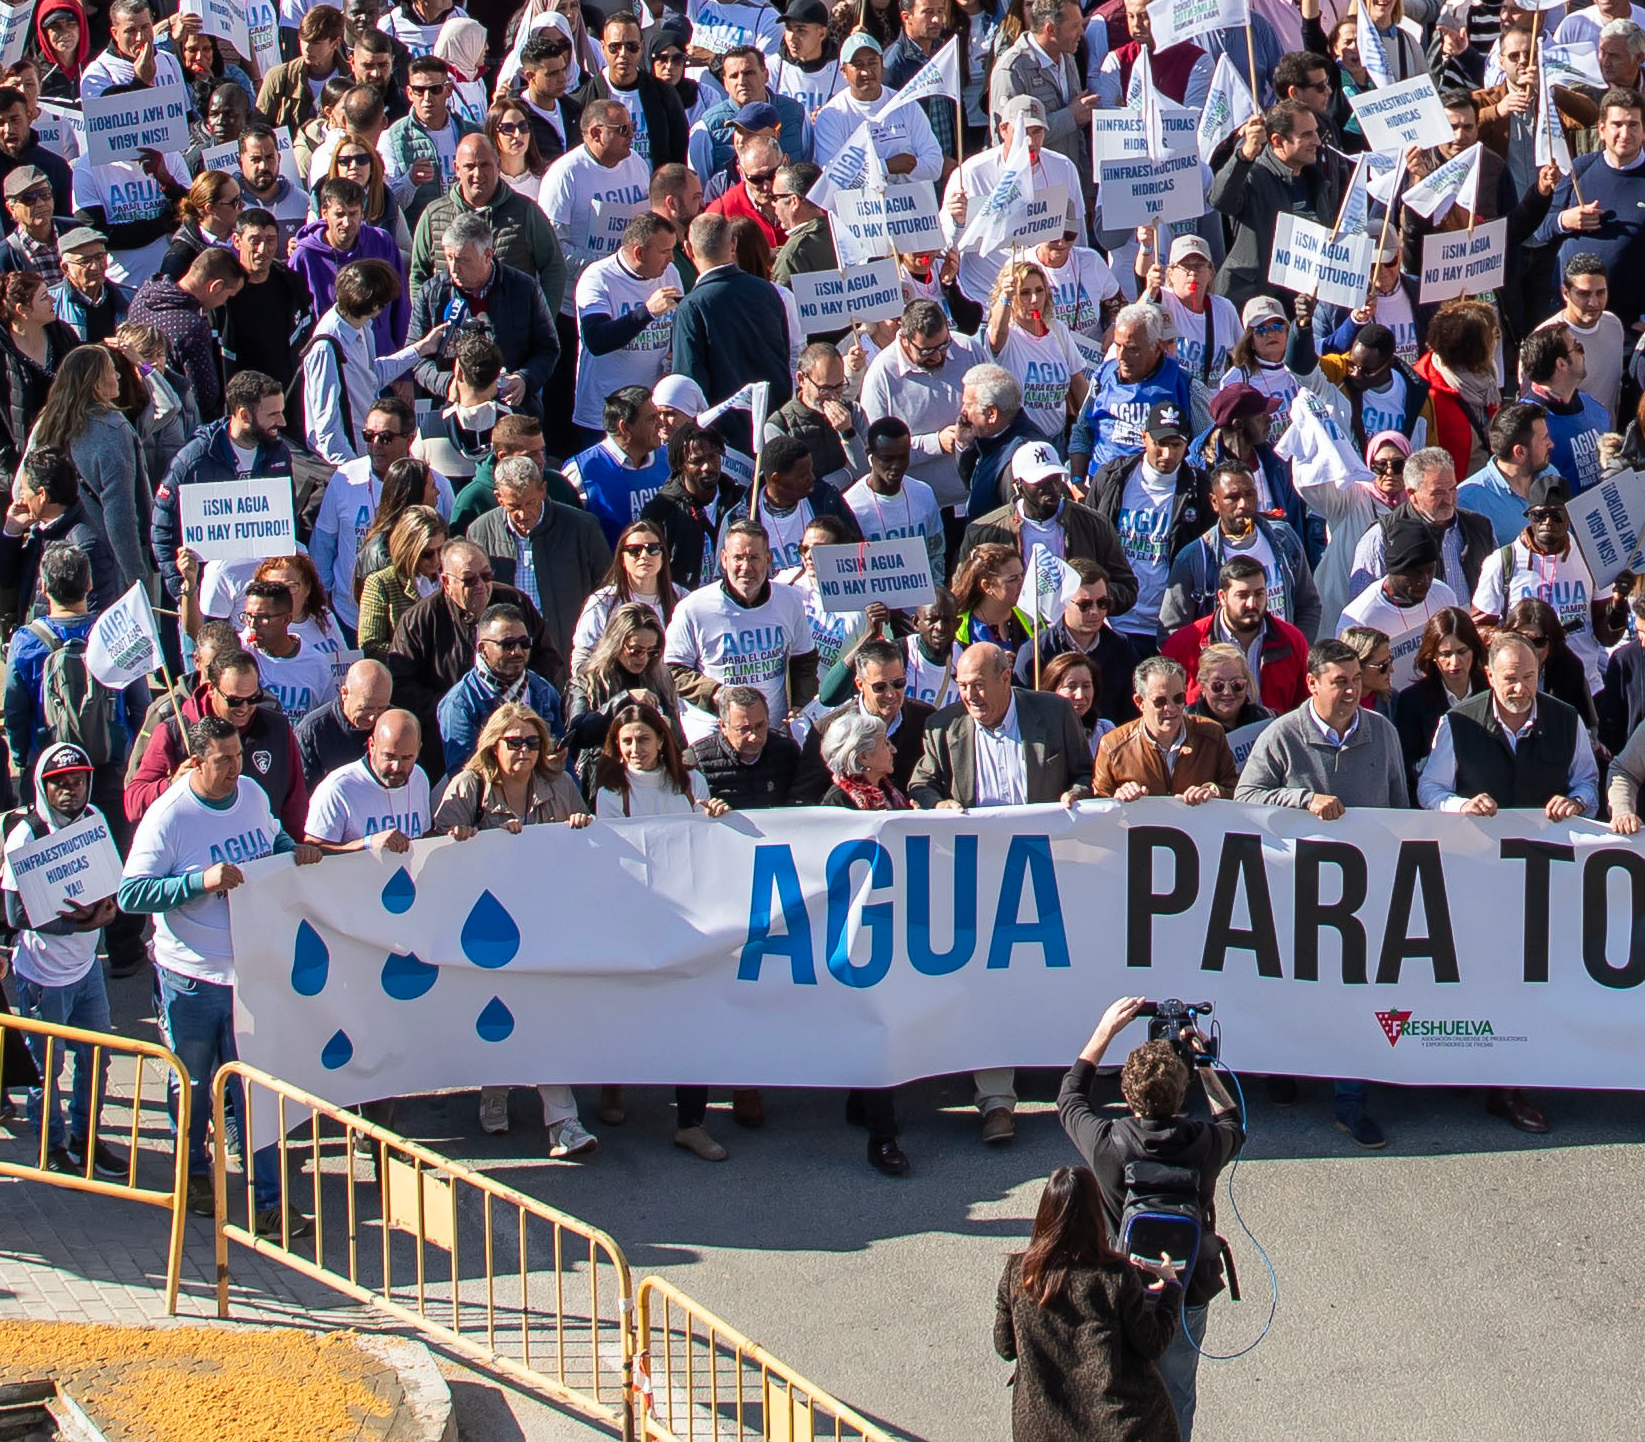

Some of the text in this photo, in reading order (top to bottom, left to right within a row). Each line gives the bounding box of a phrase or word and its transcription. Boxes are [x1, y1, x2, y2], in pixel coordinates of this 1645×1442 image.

[1275, 249, 1290, 267] NO
[1294, 256, 1313, 274] HAY
[1320, 241, 1350, 263] AGUA
[203, 496, 270, 516] ¡¡SIN AGUA
[185, 519, 290, 543] NO HAY FUTURO!!
[836, 553, 905, 574] ¡¡SIN AGUA
[821, 573, 928, 597] NO HAY FUTURO!!
[722, 626, 785, 656] AGUA
[722, 655, 747, 665] PARA
[748, 654, 759, 663] EL
[724, 675, 747, 686] PARA
[750, 674, 761, 684] EL
[366, 812, 422, 837] AGUA
[210, 827, 271, 865] AGUA
[46, 856, 90, 885] HIDRICAS
[65, 880, 85, 899] YA!!
[739, 838, 1071, 986] AGUA
[1126, 828, 1460, 985] PARA
[1392, 1019, 1494, 1037] FRESHUELVA
